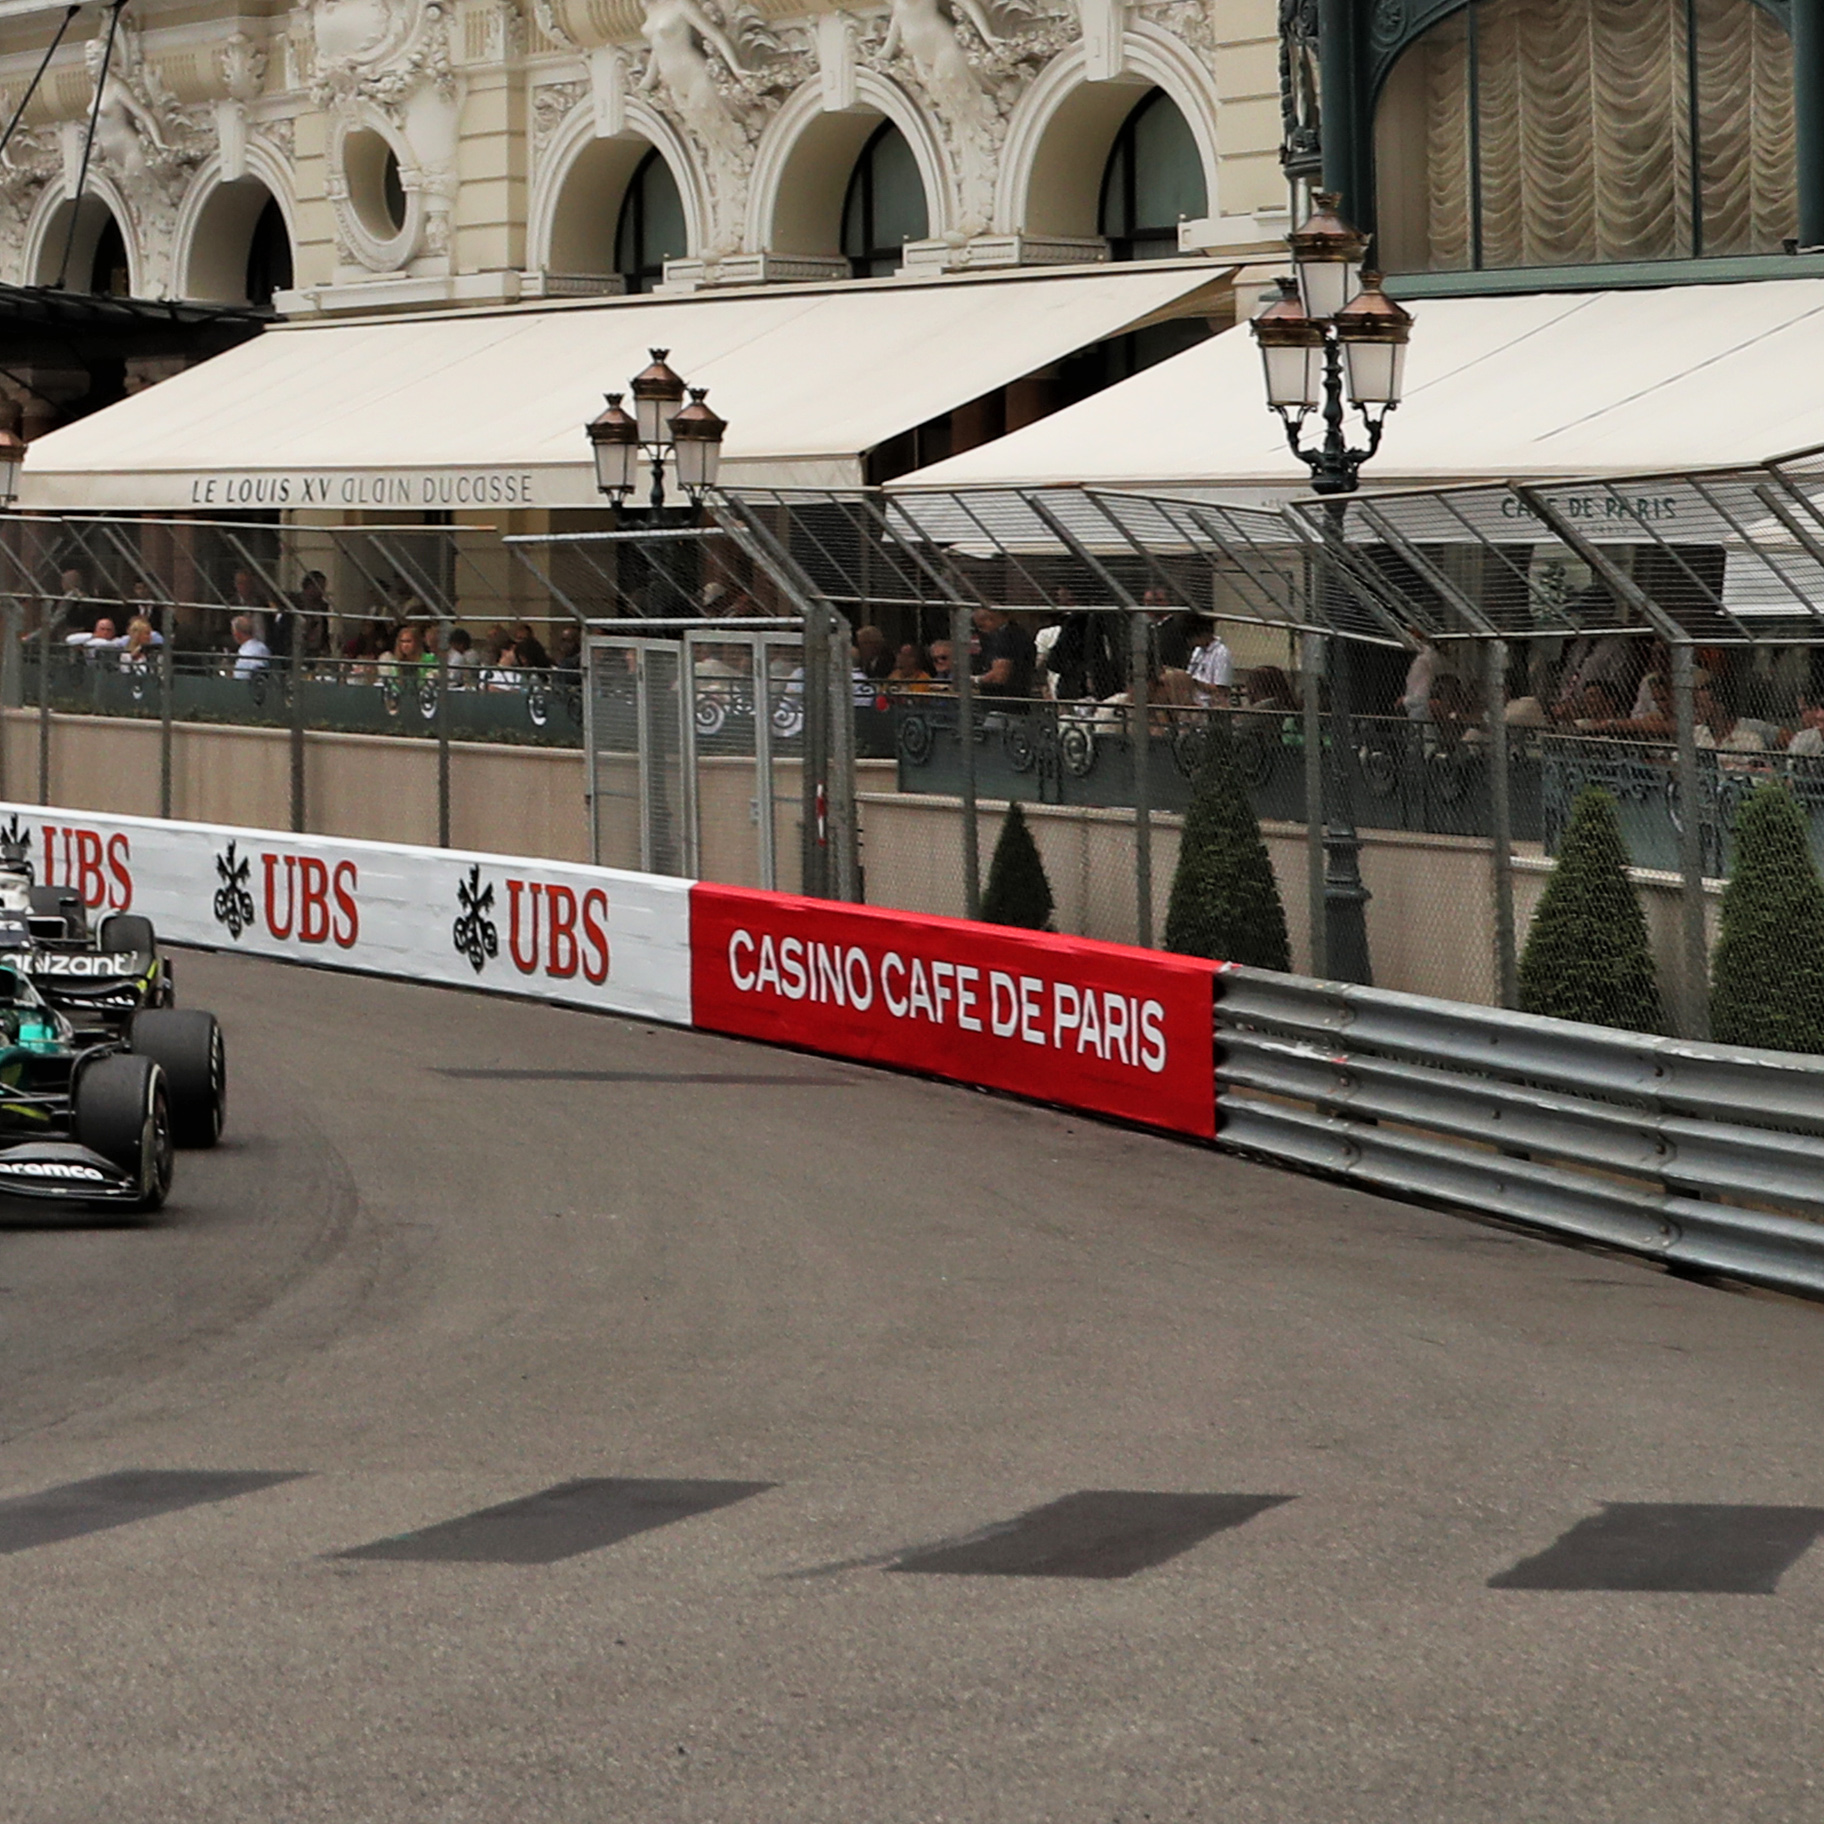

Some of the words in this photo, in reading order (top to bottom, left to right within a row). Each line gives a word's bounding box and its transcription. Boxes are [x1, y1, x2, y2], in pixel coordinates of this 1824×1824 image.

[191, 479, 217, 503] LE
[225, 478, 290, 503] LOUIS
[301, 477, 332, 502] XV
[1502, 497, 1556, 519] CAE
[1569, 497, 1592, 518] DE
[1605, 497, 1677, 519] PARIS
[42, 824, 133, 912] UBS
[261, 852, 360, 948] UBS
[505, 878, 611, 985] UBS
[728, 928, 873, 1011] CASINO
[880, 951, 983, 1033] CAFE
[989, 969, 1046, 1046] DE
[1052, 981, 1167, 1073] PARIS
